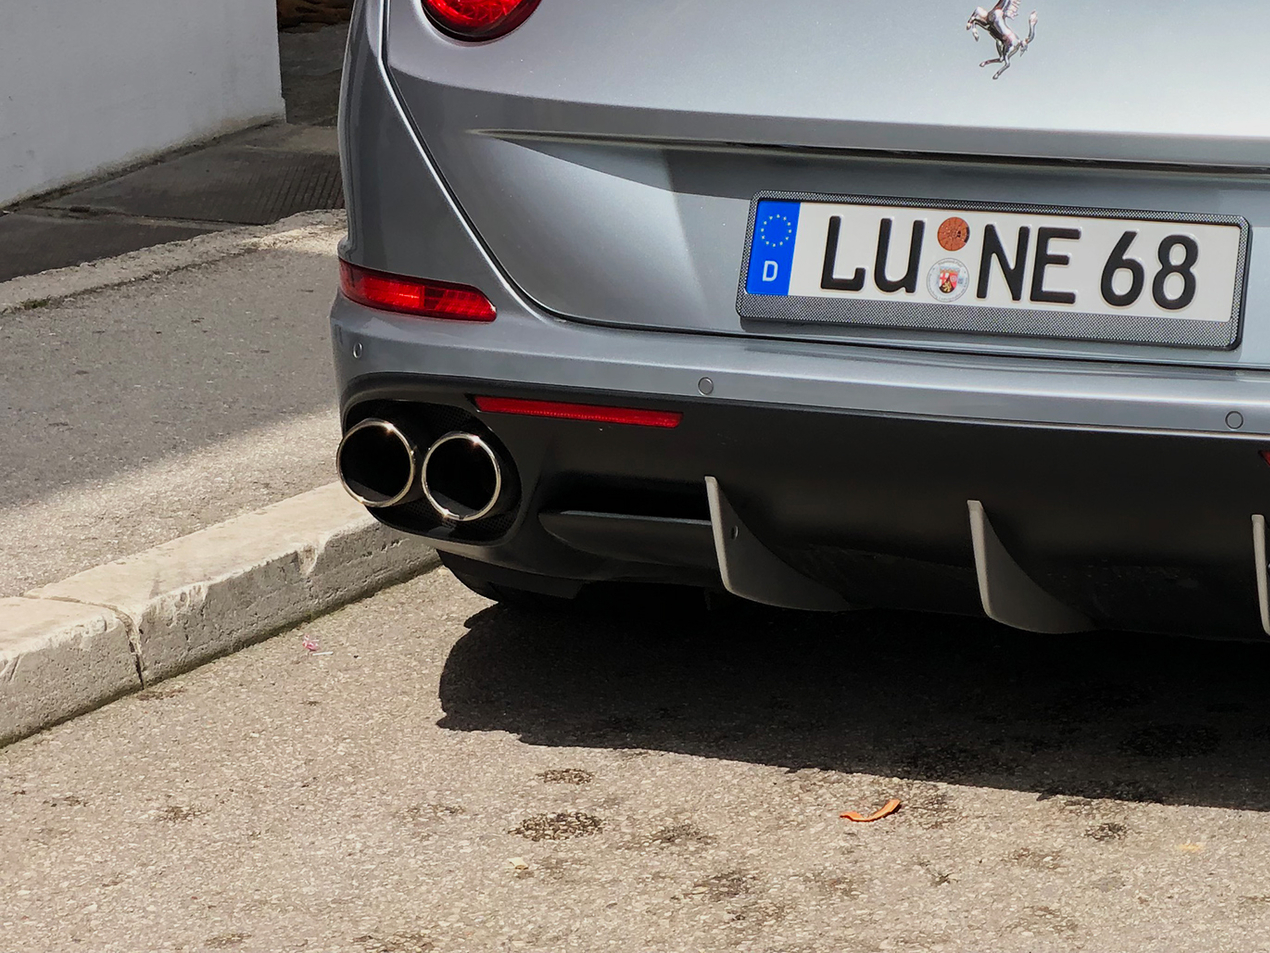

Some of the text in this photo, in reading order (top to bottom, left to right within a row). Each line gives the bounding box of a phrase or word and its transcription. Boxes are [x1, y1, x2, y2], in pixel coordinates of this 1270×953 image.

[820, 215, 926, 295] LU
[976, 223, 1083, 305] NE
[1100, 230, 1200, 310] 68
